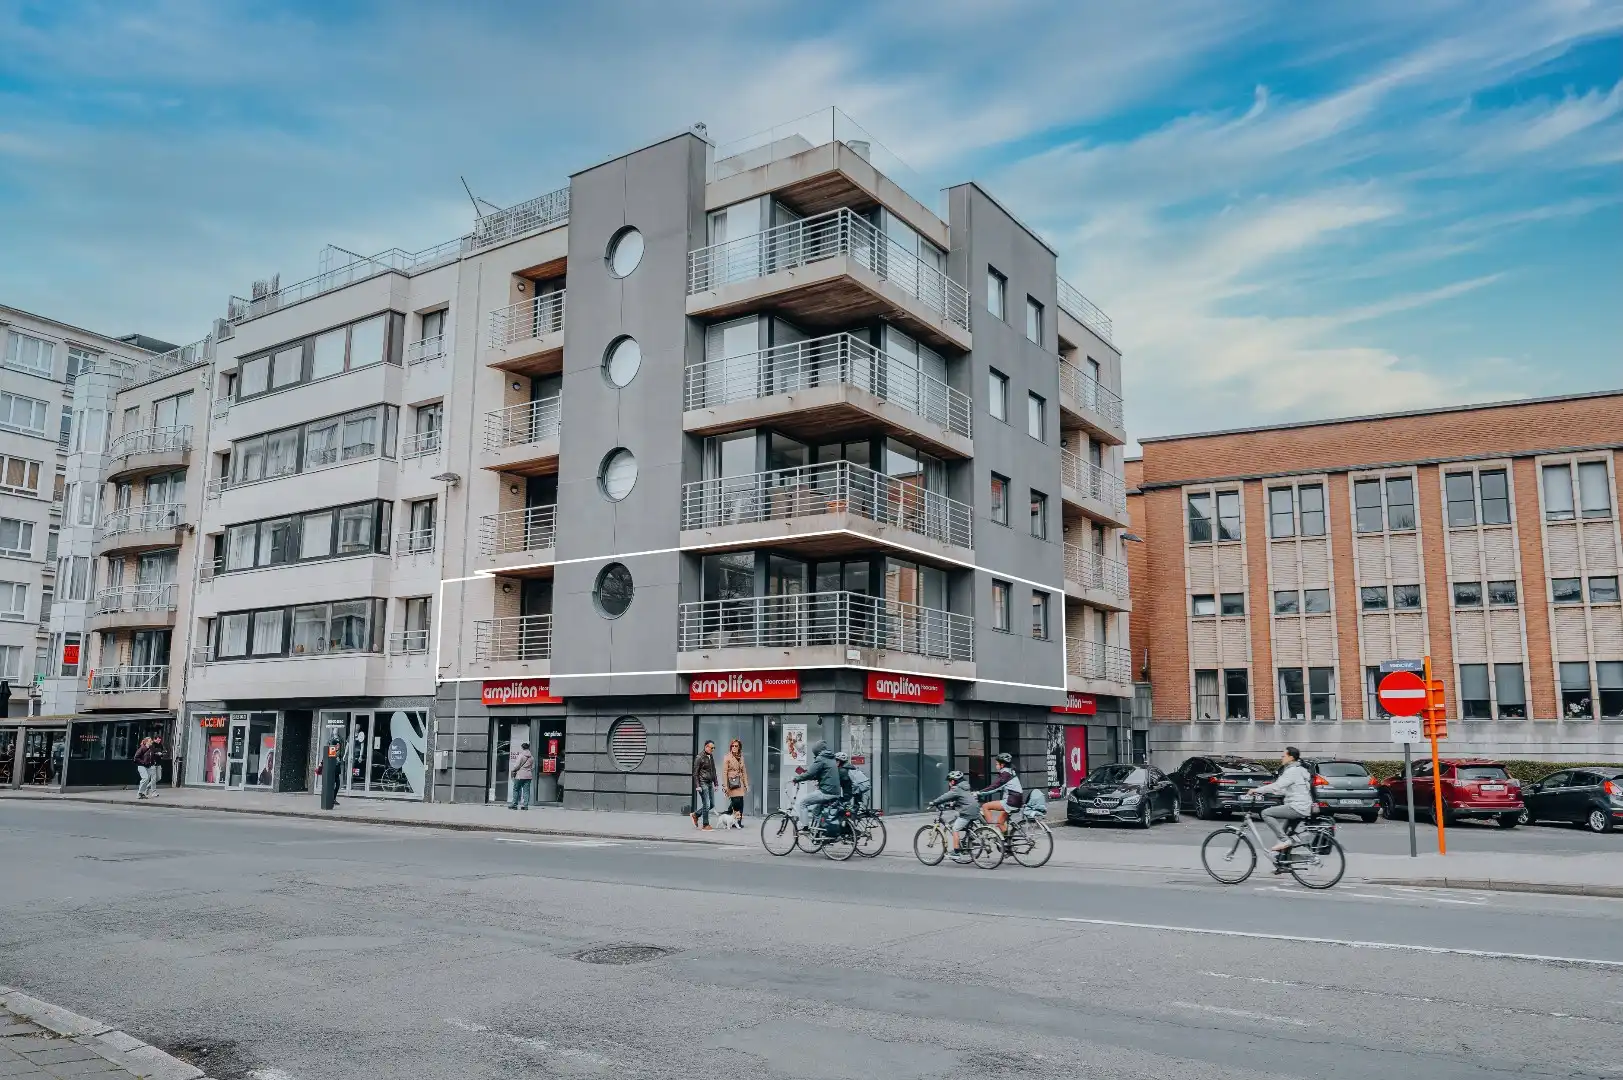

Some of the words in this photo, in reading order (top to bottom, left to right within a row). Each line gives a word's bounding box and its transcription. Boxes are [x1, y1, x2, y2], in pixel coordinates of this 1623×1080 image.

[484, 682, 538, 703] amplifon
[692, 674, 763, 698] amplifon
[876, 676, 921, 699] amplifon
[200, 715, 227, 728] ACCENT
